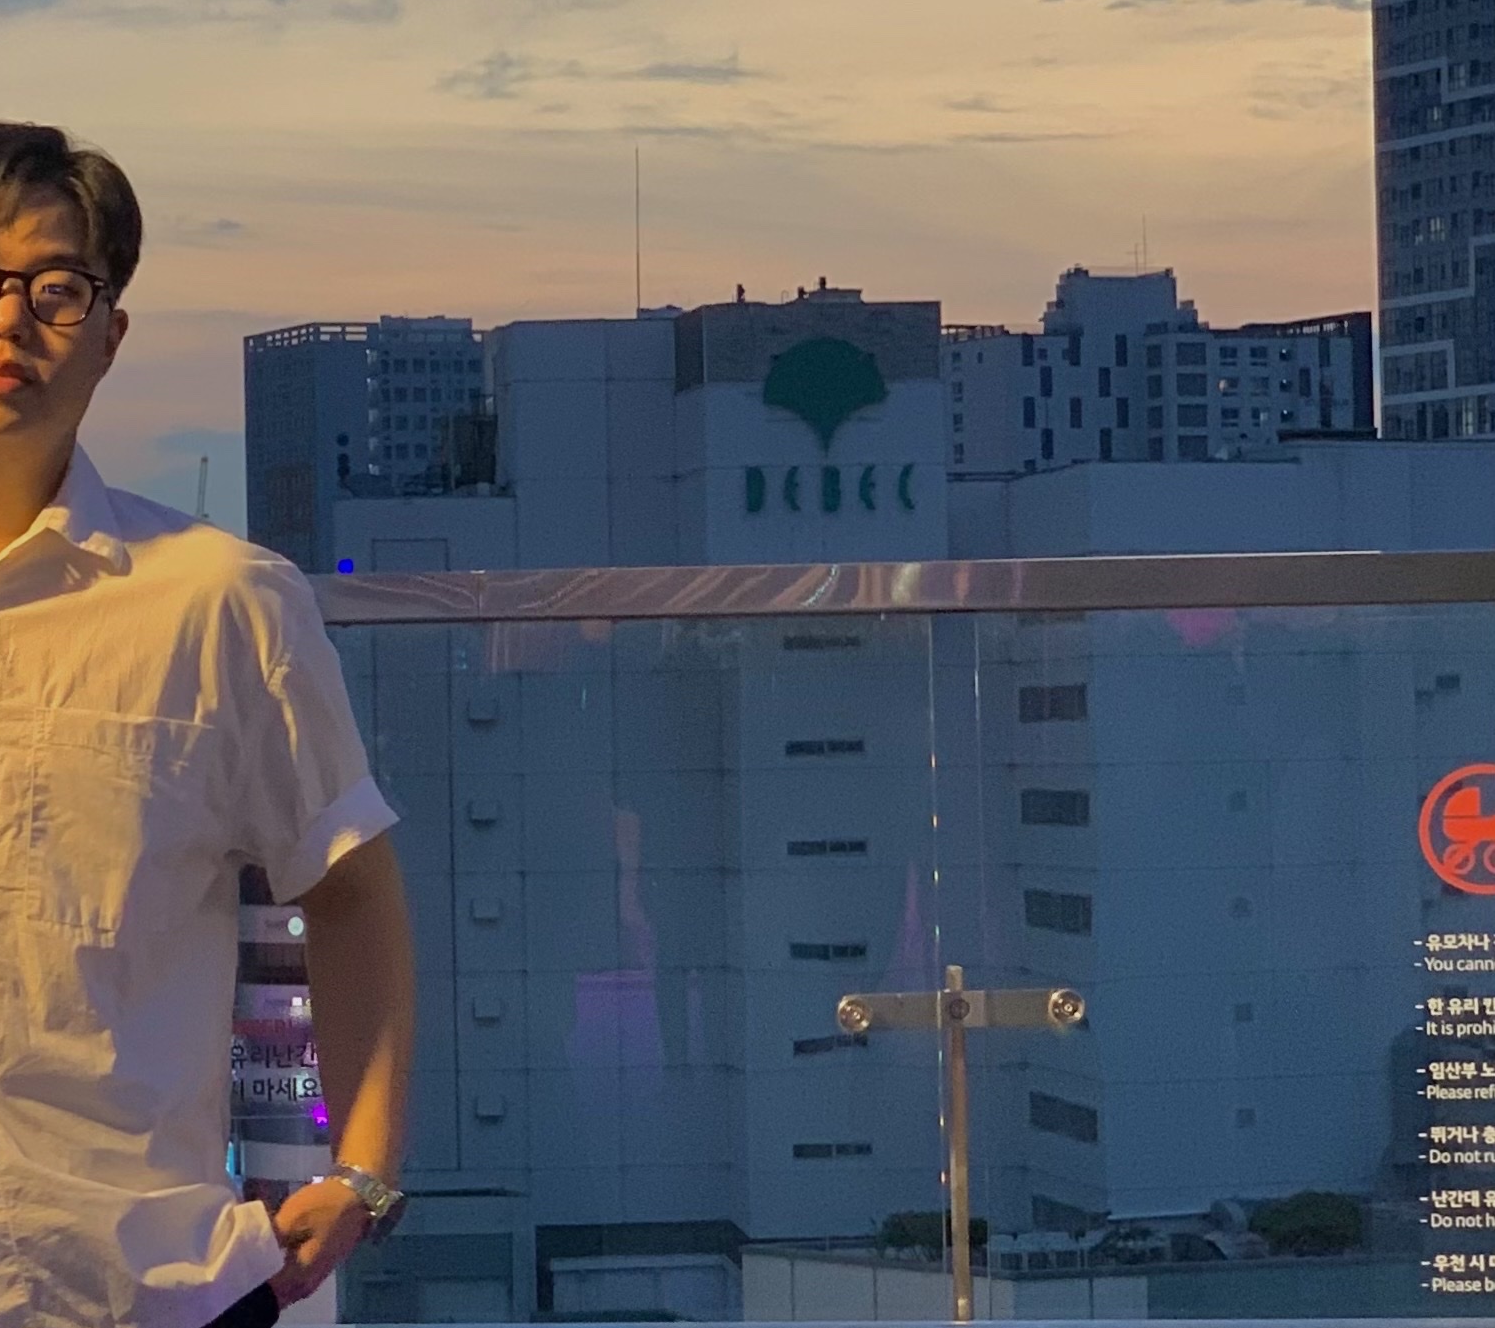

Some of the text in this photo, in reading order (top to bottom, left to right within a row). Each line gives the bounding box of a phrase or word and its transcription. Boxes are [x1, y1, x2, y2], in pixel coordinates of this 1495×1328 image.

[744, 464, 915, 513] DEBEC
[1425, 934, 1491, 951] 유모차나
[1424, 957, 1453, 971] You
[1447, 998, 1479, 1016] 유리
[1426, 1021, 1438, 1036] It
[1440, 1020, 1454, 1036] is
[1428, 1062, 1478, 1080] 임산부
[252, 1077, 323, 1103] 마세요
[1426, 1084, 1473, 1100] Please
[1430, 1125, 1480, 1144] 뛰거나
[1429, 1149, 1451, 1164] Do
[1454, 1150, 1482, 1164] not
[1431, 1190, 1481, 1208] 난간대
[1430, 1212, 1453, 1228] Do
[1455, 1214, 1483, 1228] not
[1432, 1254, 1466, 1272] 우천
[1469, 1254, 1485, 1272] 시
[1432, 1276, 1482, 1292] Please
